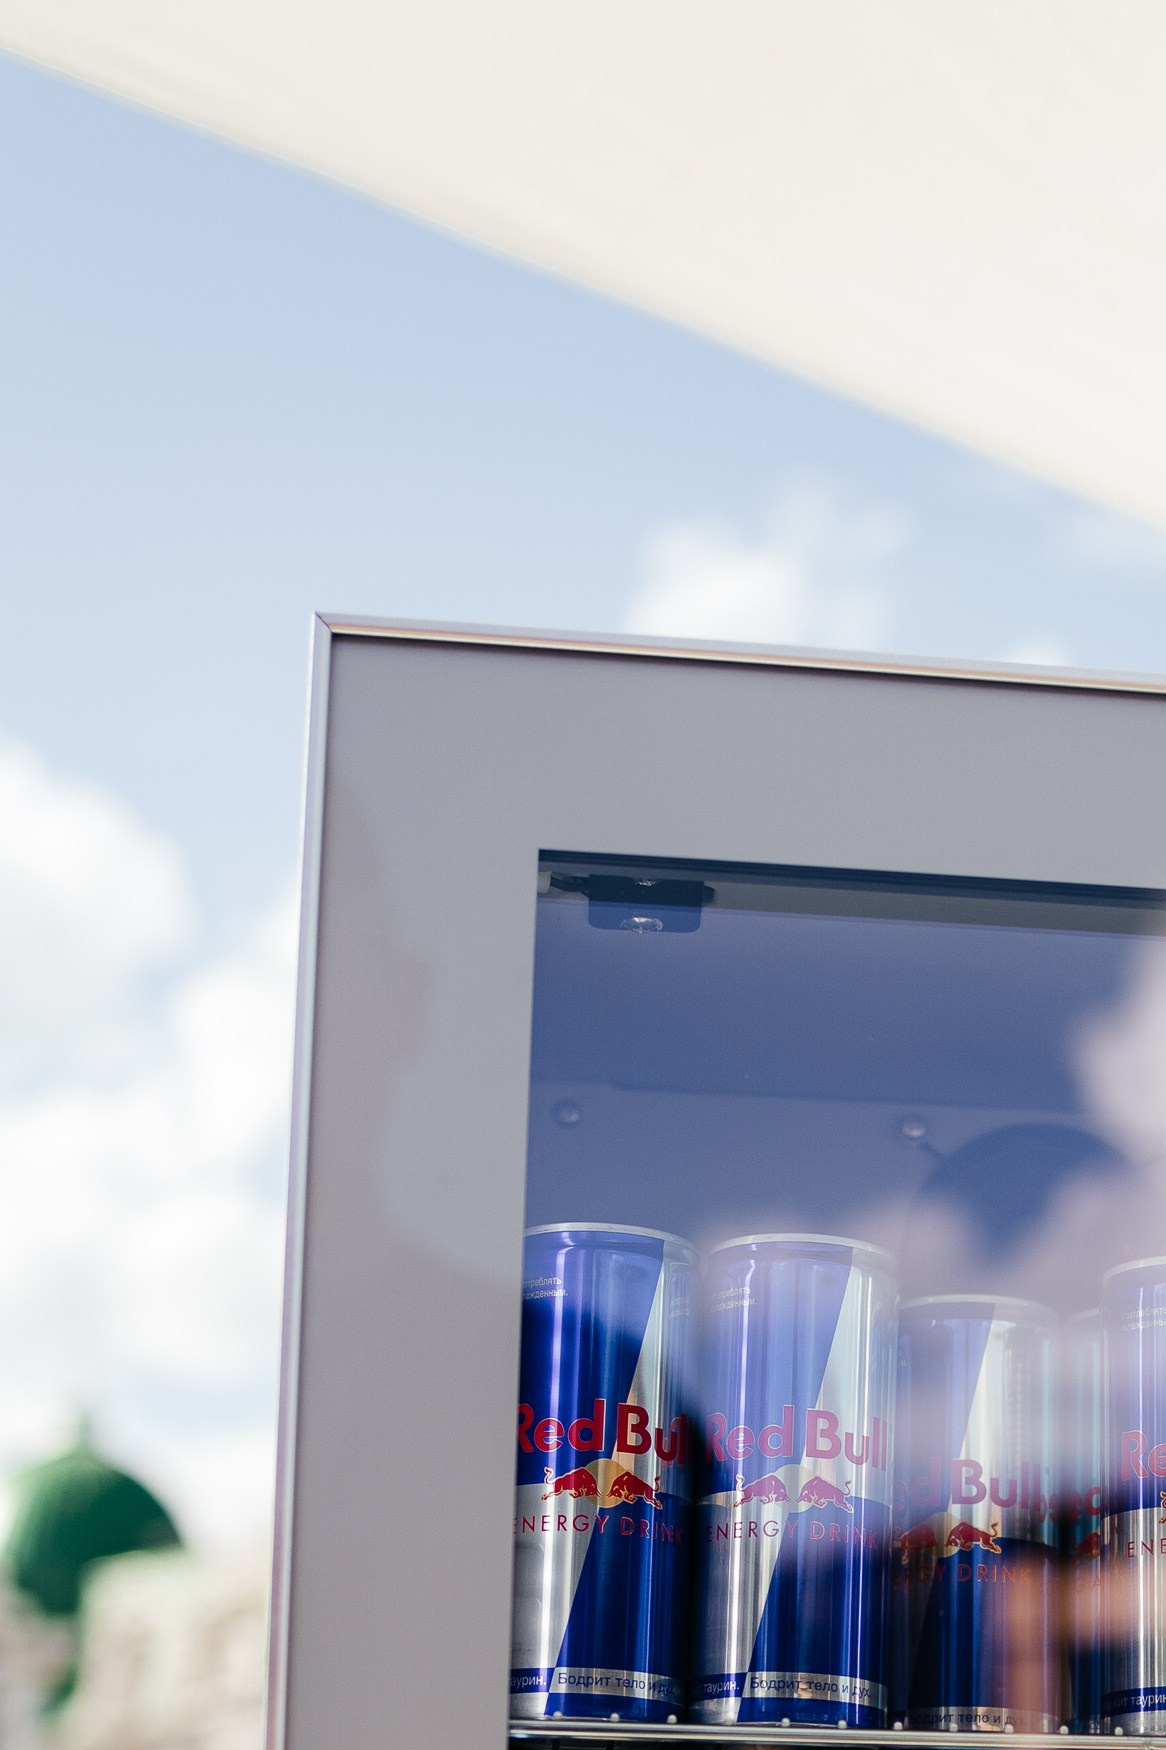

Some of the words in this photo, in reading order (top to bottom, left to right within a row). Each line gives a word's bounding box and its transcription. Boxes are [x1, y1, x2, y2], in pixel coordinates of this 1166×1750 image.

[705, 1405, 795, 1464] Red
[806, 1407, 888, 1473] Bull
[951, 1459, 1041, 1512] Bull
[706, 1520, 799, 1543] ENERGY
[809, 1521, 877, 1548] DRINK
[511, 1677, 547, 1688] аурин.
[558, 1672, 611, 1688] Бодрит
[615, 1677, 646, 1690] тело
[750, 1676, 800, 1692] Бодрит
[806, 1681, 838, 1693] тело
[958, 1713, 989, 1724] тело
